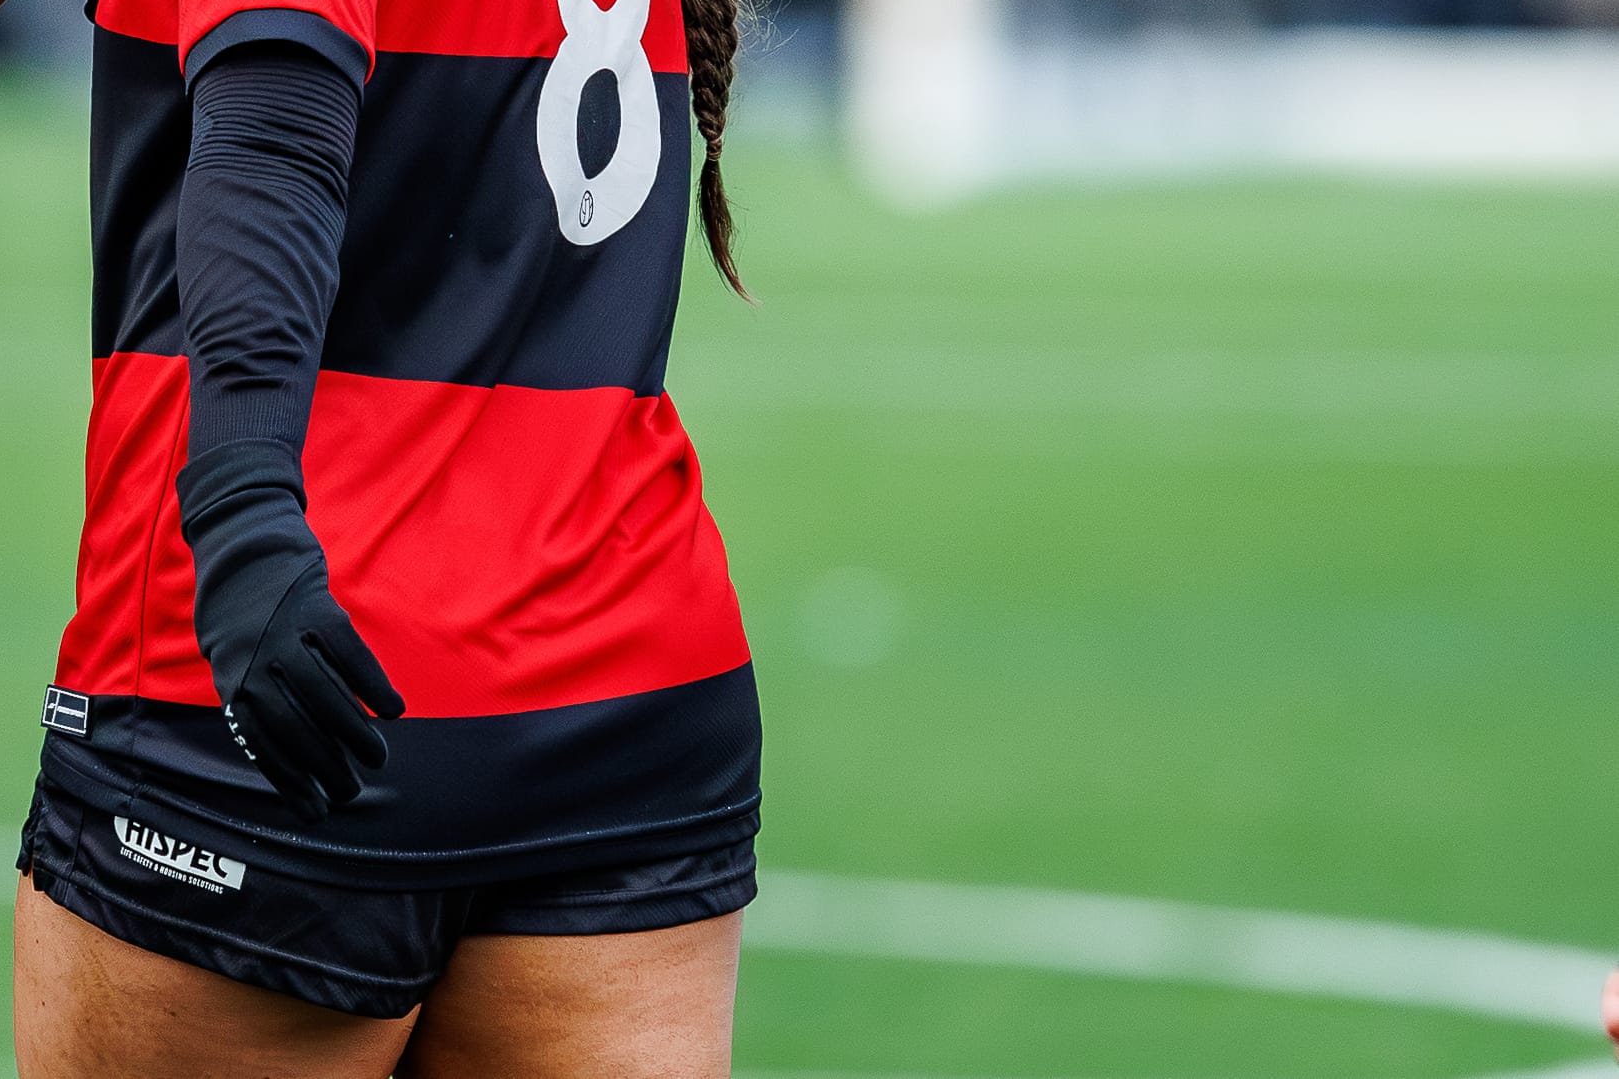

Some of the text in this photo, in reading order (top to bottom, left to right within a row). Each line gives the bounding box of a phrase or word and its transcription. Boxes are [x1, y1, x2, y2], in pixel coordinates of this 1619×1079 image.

[120, 846, 132, 859] LIFE
[133, 852, 153, 869] SAFETY
[159, 865, 187, 882] HOUSING
[187, 875, 224, 895] SOLUTIONS
